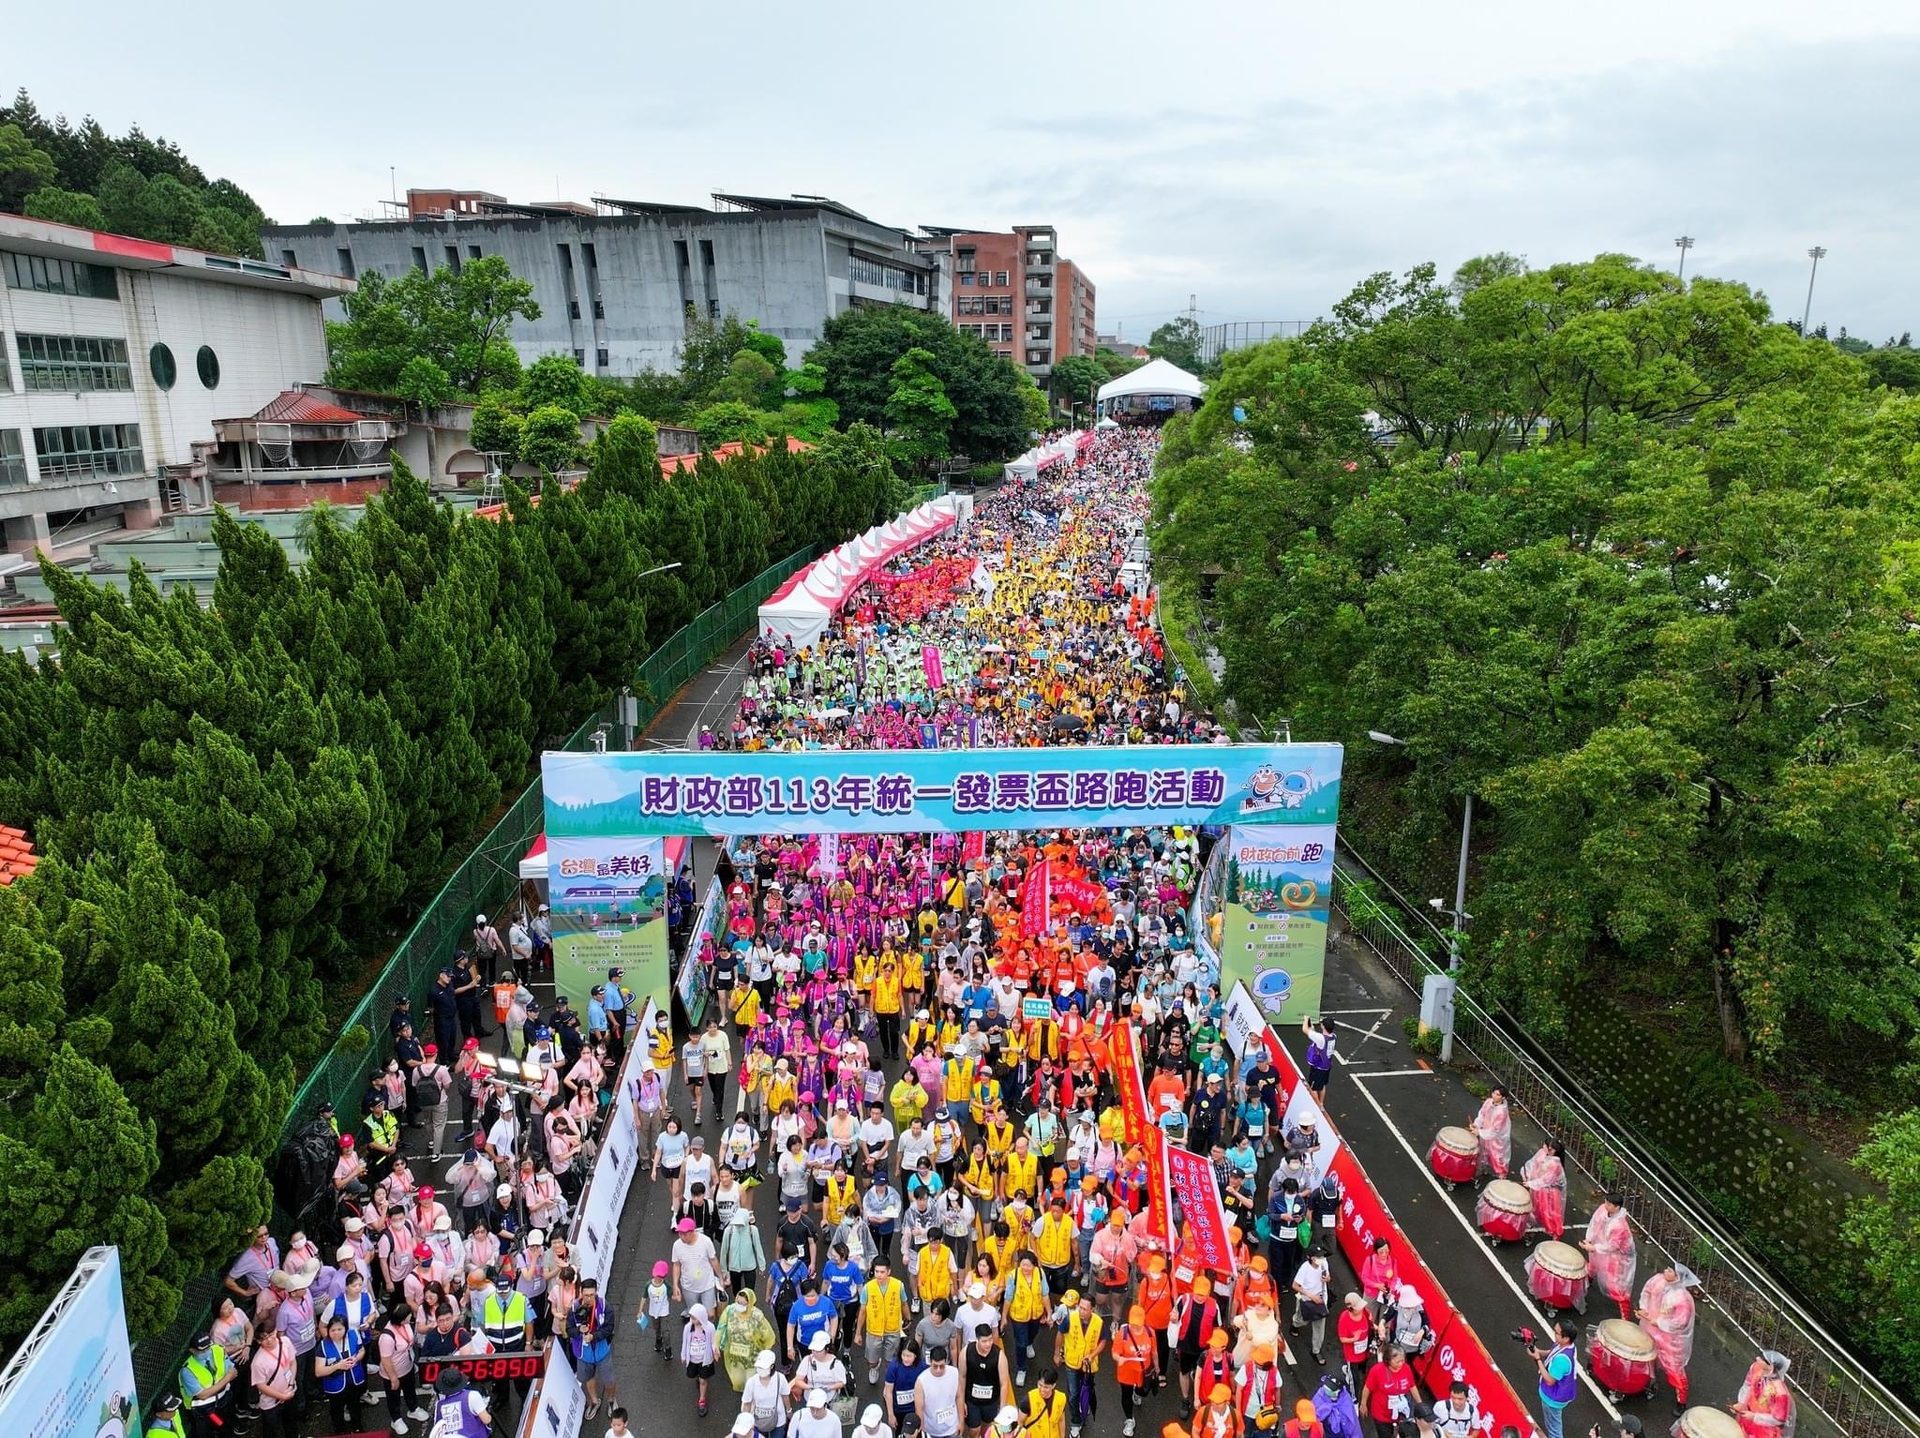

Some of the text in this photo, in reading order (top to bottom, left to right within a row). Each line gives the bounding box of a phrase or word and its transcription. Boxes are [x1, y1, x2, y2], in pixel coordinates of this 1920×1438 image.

[643, 769, 1225, 812] 財政部113年統一發票盃路跑活動
[1240, 843, 1324, 861] 財政向前跑
[560, 854, 652, 876] 台灣最美好
